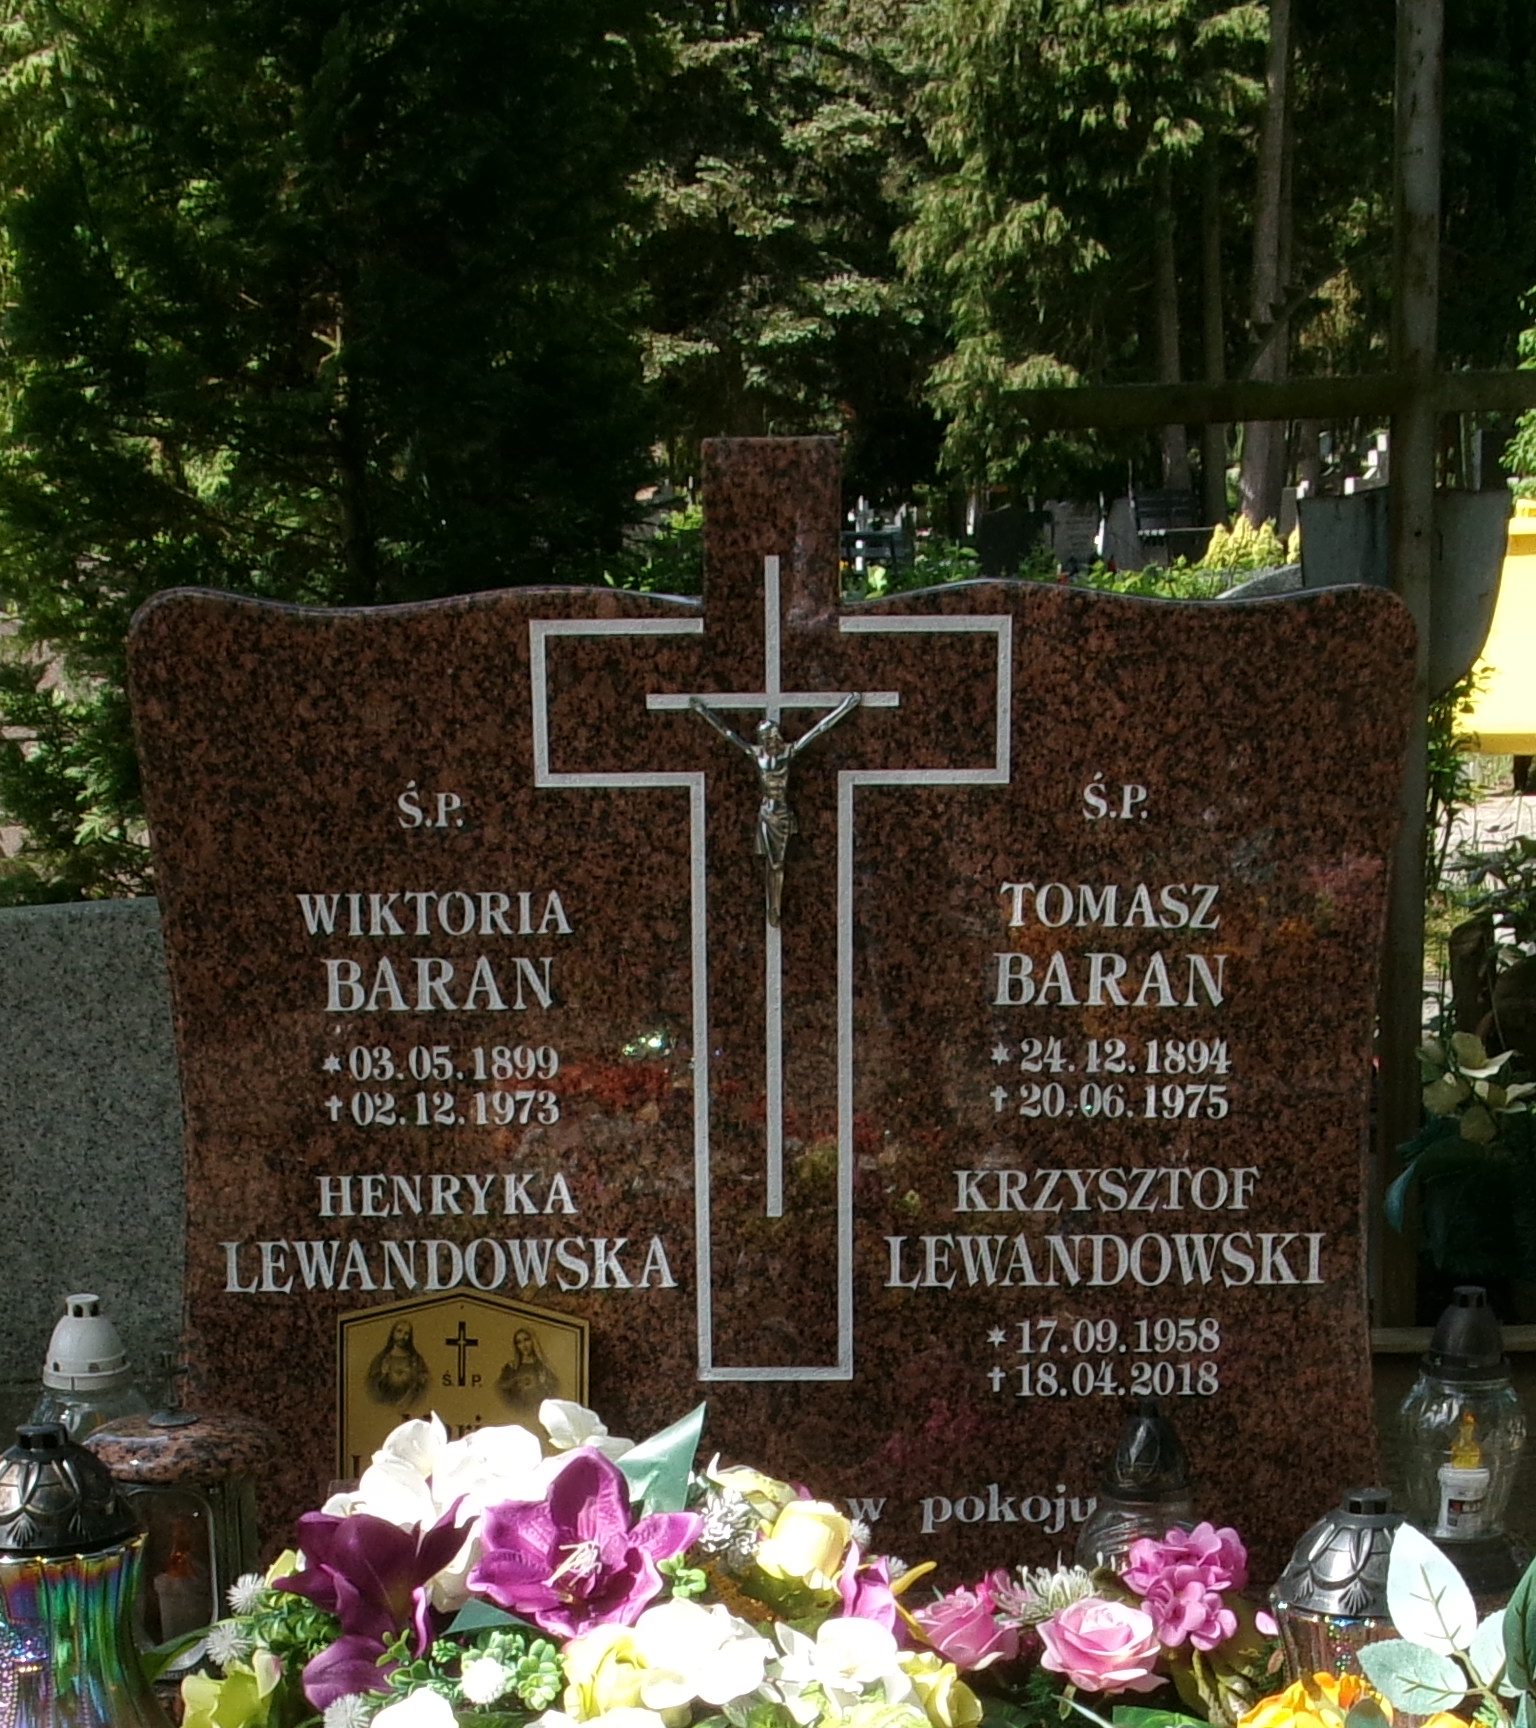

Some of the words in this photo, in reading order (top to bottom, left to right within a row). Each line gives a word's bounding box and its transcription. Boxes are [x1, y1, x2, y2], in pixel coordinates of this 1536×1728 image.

[397, 780, 465, 829] Ś.P.
[1082, 771, 1148, 821] Ś.P.
[296, 889, 575, 936] WIKTORIA
[1000, 881, 1222, 930] TOMASZ
[320, 955, 554, 1013] BARAN
[992, 950, 1229, 1008] BARAN
[316, 1171, 579, 1218] HENRYKA
[952, 1165, 1260, 1215] KRZYSZTOF
[218, 1234, 678, 1294] LEWANDOWSKA
[882, 1230, 1327, 1290] LEWANDOWSKI
[845, 1497, 887, 1523] w
[920, 1483, 1098, 1535] pokoju
